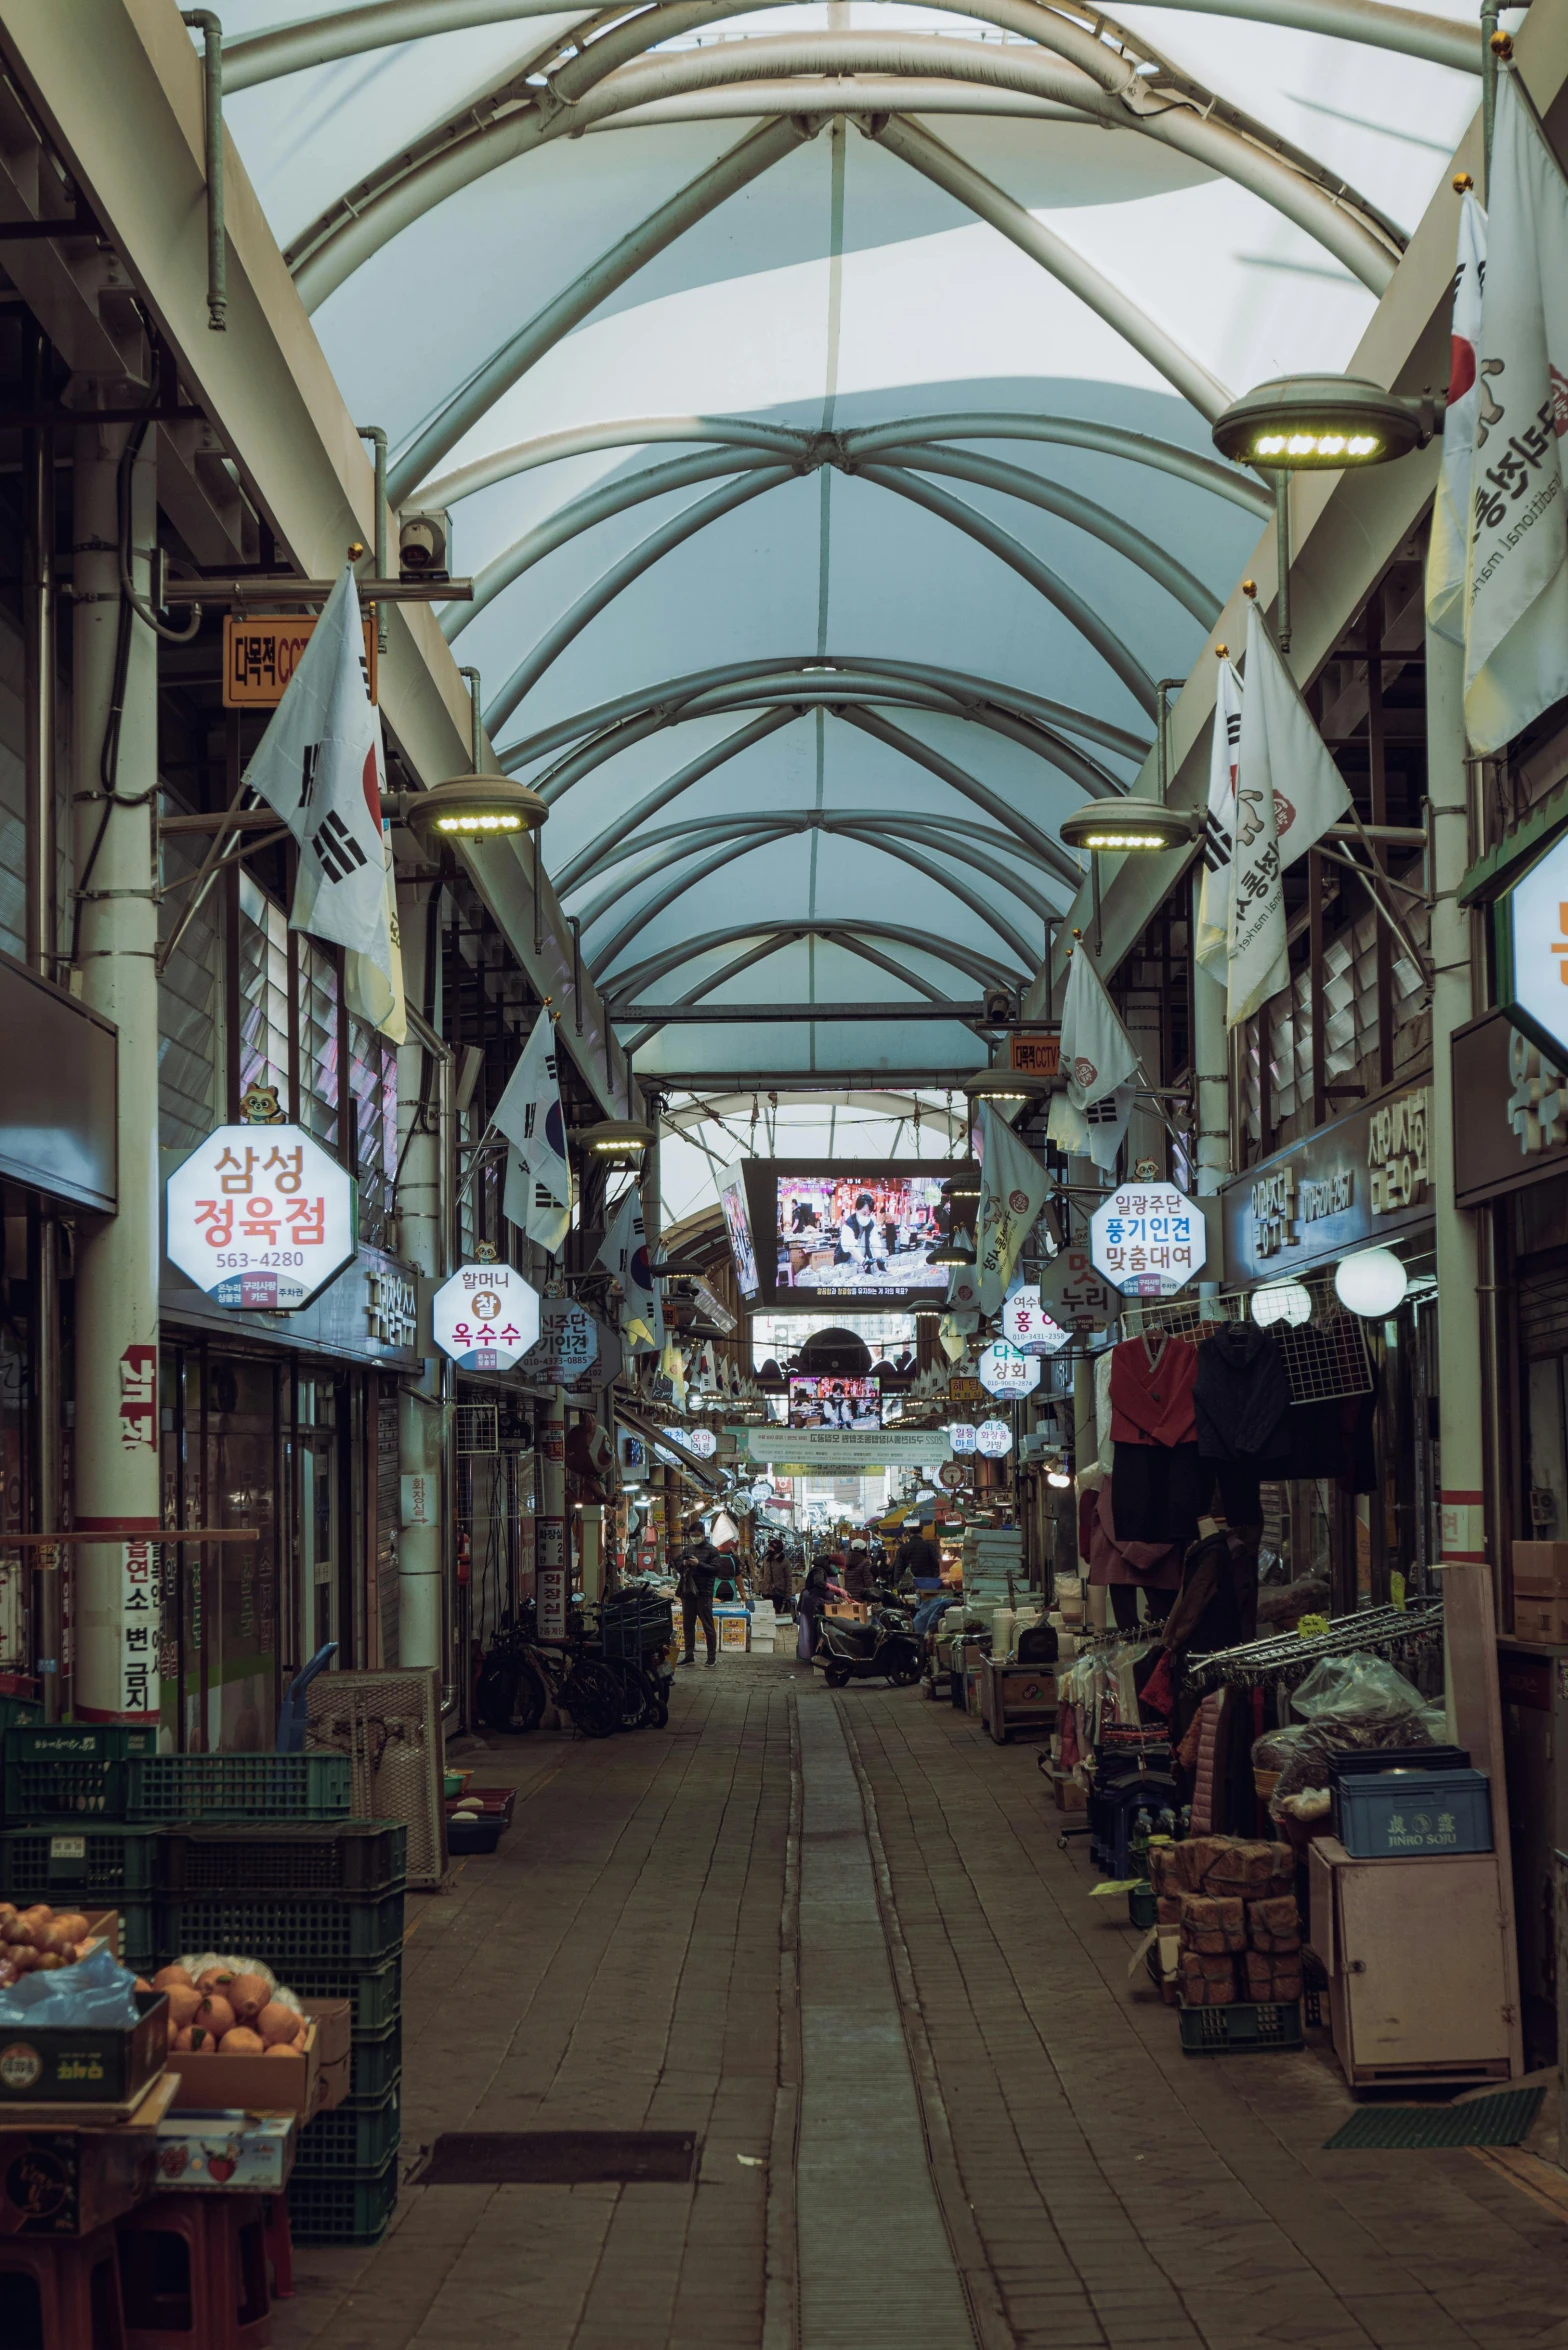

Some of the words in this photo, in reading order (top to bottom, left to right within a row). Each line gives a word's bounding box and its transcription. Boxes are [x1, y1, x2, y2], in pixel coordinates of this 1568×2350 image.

[214, 1145, 304, 1194] 삼성
[1115, 1194, 1182, 1215] 일광주단
[194, 1196, 325, 1248] 정육점
[1105, 1217, 1191, 1244] 풍기인견
[216, 1251, 304, 1268] 563-4280
[1106, 1245, 1192, 1272] 맞춤대여
[461, 1271, 510, 1289] 할머니
[251, 1292, 269, 1302] 카드
[278, 1287, 304, 1297] 주차권
[858, 1287, 877, 1295] 유지하는
[884, 1287, 894, 1295] 저의
[1061, 1287, 1108, 1312] 누리
[475, 1294, 498, 1318] 찰
[541, 1313, 588, 1334] 신주단
[451, 1322, 522, 1347] 옥수수
[1012, 1333, 1065, 1341] 010-3431-2358
[528, 1335, 588, 1356] 기인견
[523, 1357, 588, 1366] 010-4373-0885
[993, 1362, 1026, 1380] 상회
[692, 1434, 711, 1442] 모아
[955, 1427, 975, 1439] 일등
[955, 1439, 975, 1448] 마트
[986, 1440, 1002, 1450] 가방
[412, 1477, 426, 1516] 화장실
[539, 1529, 563, 1540] 화장실
[543, 1573, 562, 1615] 화장실
[124, 1663, 149, 1712] 금지
[1388, 1834, 1423, 1848] JINRO
[1426, 1833, 1457, 1846] SOJU
